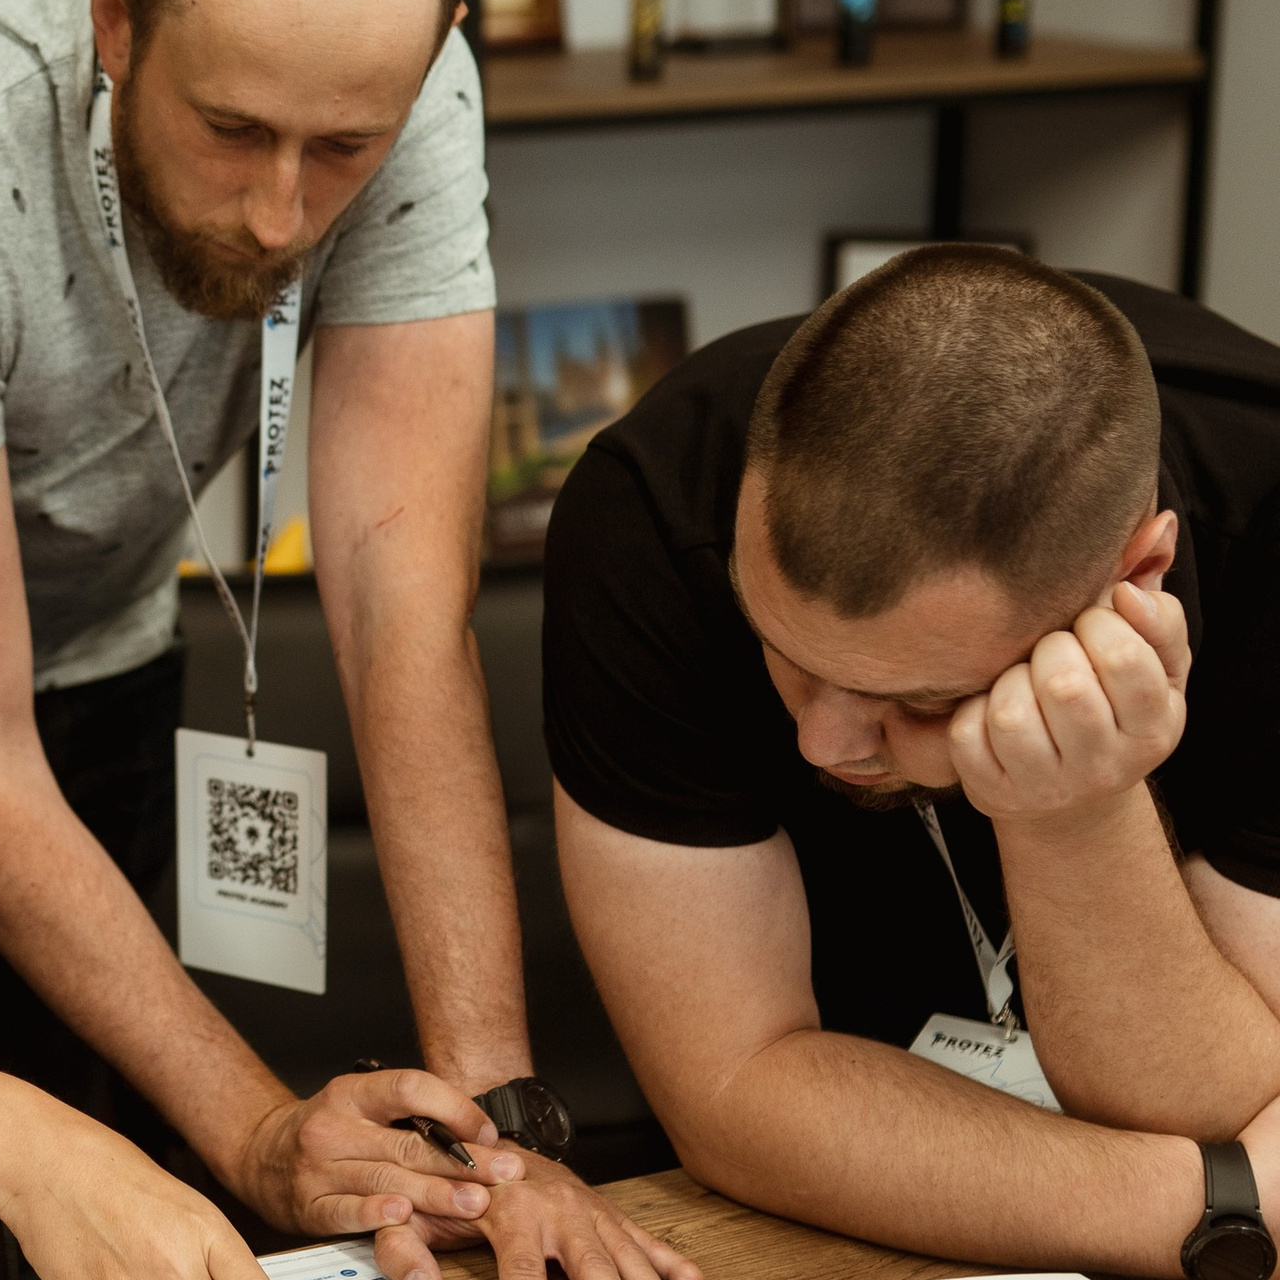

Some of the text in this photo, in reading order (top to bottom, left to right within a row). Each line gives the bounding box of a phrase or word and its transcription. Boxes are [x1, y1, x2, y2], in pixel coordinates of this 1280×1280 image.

[94, 148, 119, 247] PROTEZ
[266, 377, 285, 475] PROTEZ
[932, 1033, 1006, 1058] PROTEZ
